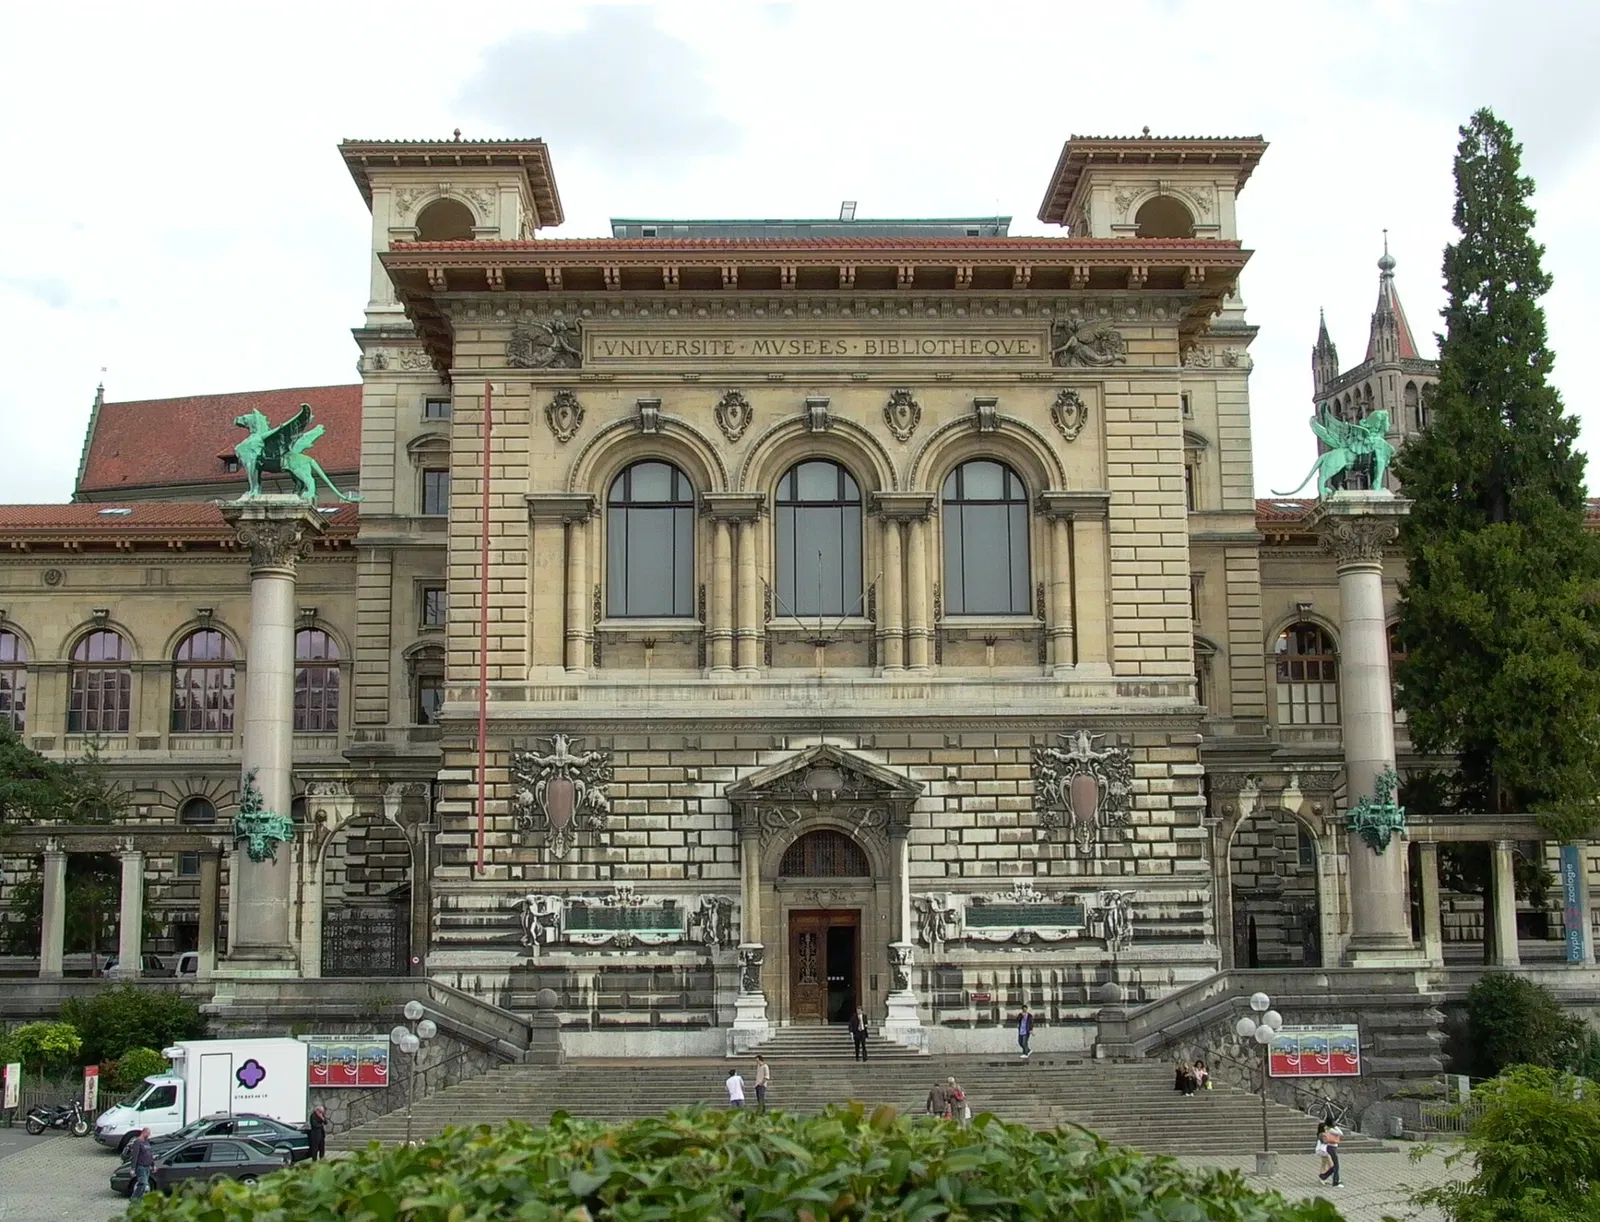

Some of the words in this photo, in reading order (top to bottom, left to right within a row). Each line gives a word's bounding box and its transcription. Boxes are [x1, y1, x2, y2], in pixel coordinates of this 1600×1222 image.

[750, 339, 848, 355] MVSEES
[1565, 863, 1576, 903] zoologie
[1570, 930, 1580, 960] crypto
